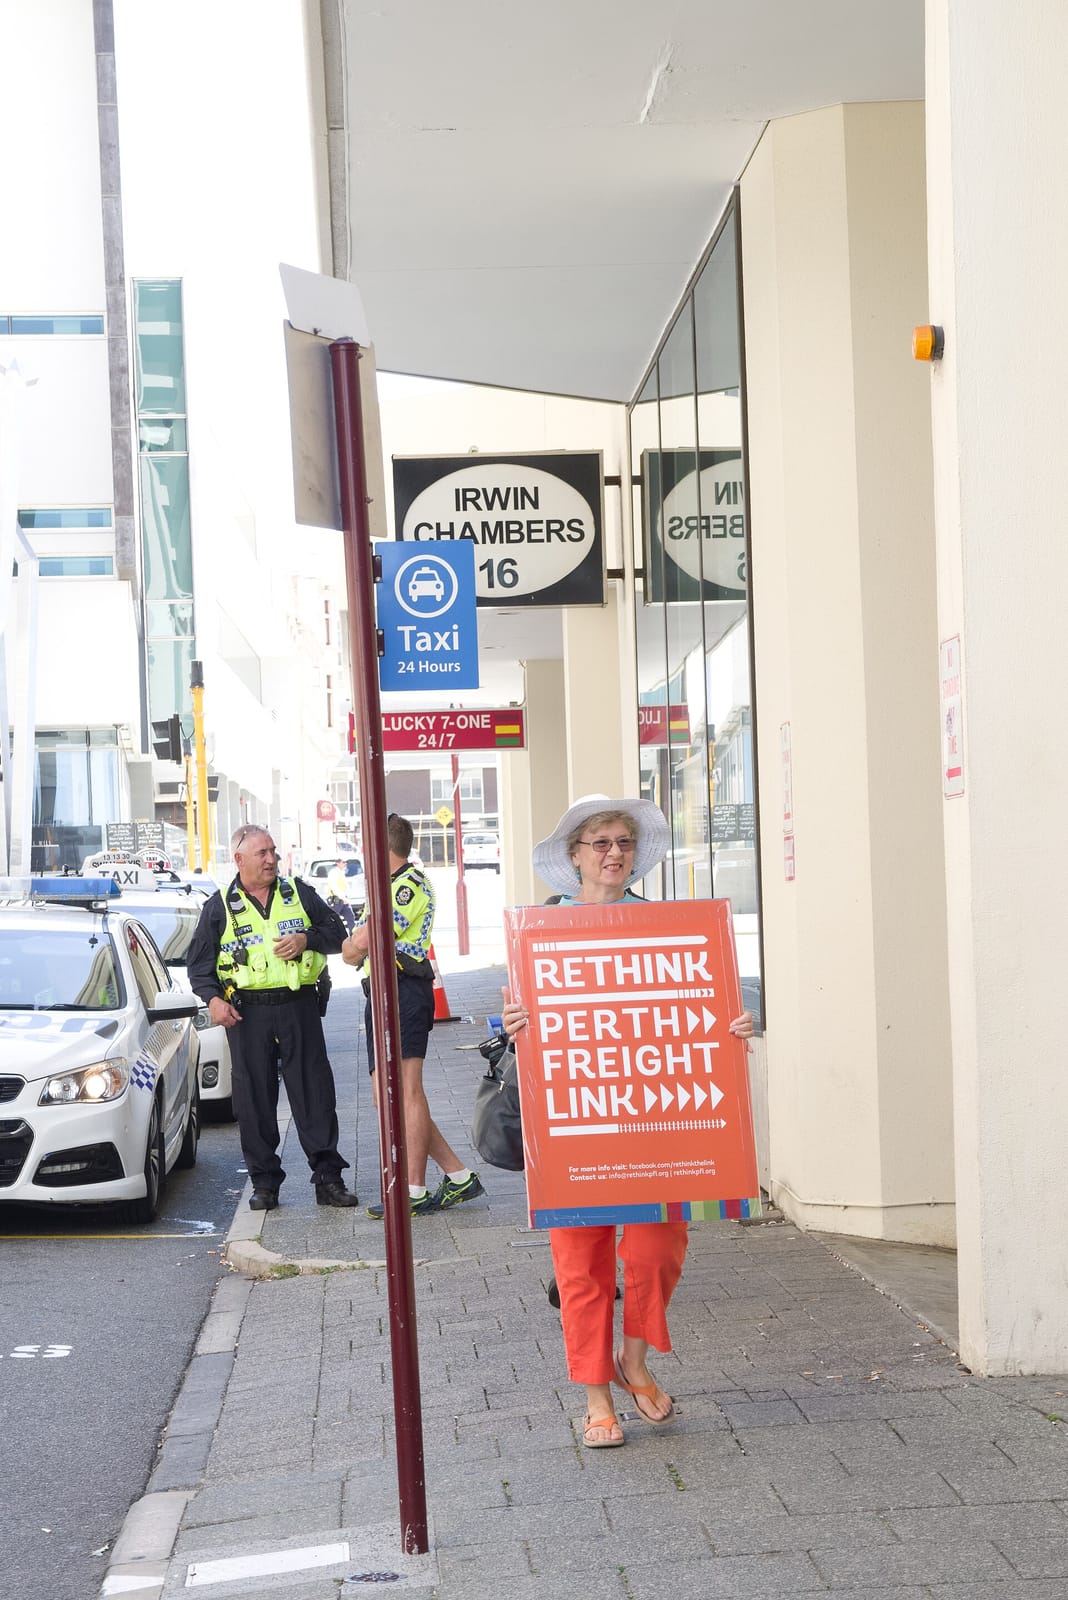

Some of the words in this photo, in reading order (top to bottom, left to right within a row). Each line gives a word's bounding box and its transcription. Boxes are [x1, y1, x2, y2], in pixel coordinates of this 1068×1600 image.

[454, 486, 540, 512] IRWIN
[413, 518, 586, 545] CHAMBERS
[479, 557, 519, 589] 16
[397, 624, 460, 652] Taxi
[397, 661, 415, 674] 24
[418, 660, 462, 673] Hours
[381, 715, 436, 731] LUCKY
[440, 714, 491, 730] 7-ONE
[417, 733, 456, 749] 24/7
[278, 919, 304, 930] POLICE
[533, 951, 713, 990] RETHINK
[539, 1005, 681, 1043] PERTH
[542, 1042, 720, 1081] FREIGHT
[545, 1084, 639, 1120] LINK
